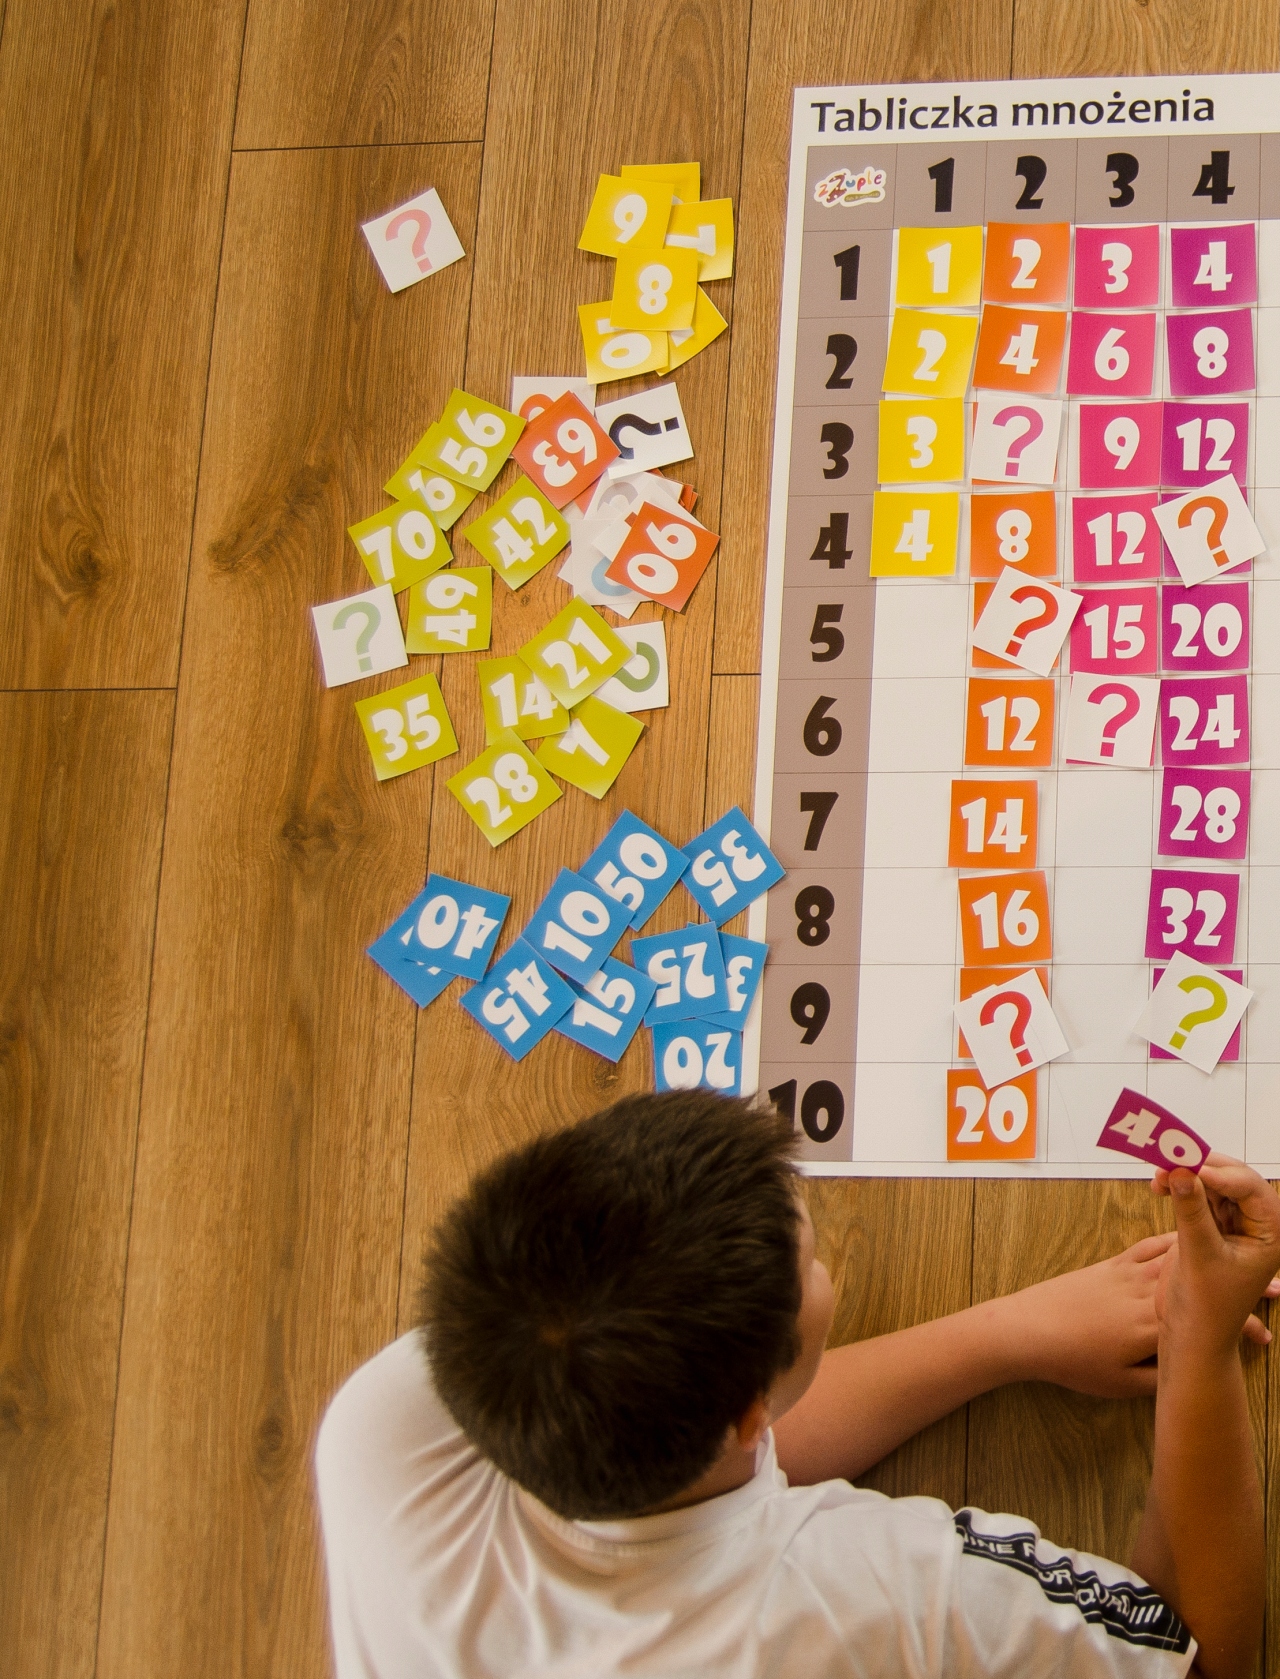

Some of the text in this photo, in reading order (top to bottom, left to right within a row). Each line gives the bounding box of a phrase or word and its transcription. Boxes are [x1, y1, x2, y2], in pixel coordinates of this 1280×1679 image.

[811, 89, 1215, 133] Tabliczka mnożenia
[927, 157, 955, 212] 1
[1015, 155, 1048, 209] 2
[1106, 152, 1139, 207] 3
[1192, 150, 1235, 204] 4
[614, 194, 647, 244] 9
[638, 264, 673, 315] 8
[833, 244, 860, 300] 1
[926, 242, 952, 293] 1
[1011, 238, 1042, 289] 2
[1101, 242, 1133, 294] 3
[1193, 241, 1233, 292] 4
[825, 333, 858, 389] 2
[913, 329, 947, 382] 2
[1000, 324, 1039, 375] 4
[1094, 327, 1130, 381] 6
[1192, 326, 1229, 379] 8
[439, 408, 506, 479] 56
[531, 418, 597, 488] 63
[820, 422, 854, 480] 3
[906, 416, 938, 469] 3
[1104, 416, 1140, 470] 9
[1175, 418, 1236, 471] 12
[360, 510, 437, 581] 70
[493, 497, 558, 570] 42
[627, 521, 697, 595] 90
[809, 513, 853, 569] 4
[894, 510, 934, 561] 4
[996, 509, 1032, 562] 8
[1086, 511, 1147, 567] 12
[425, 574, 479, 646] 49
[809, 604, 845, 662] 5
[1083, 604, 1146, 659] 15
[1171, 602, 1243, 657] 20
[542, 617, 613, 689] 21
[372, 693, 441, 761] 35
[490, 672, 558, 727] 14
[803, 696, 842, 756] 6
[980, 696, 1041, 751] 12
[1167, 695, 1241, 751] 24
[558, 718, 611, 767] 7
[466, 752, 539, 828] 28
[1169, 785, 1241, 843] 28
[800, 791, 839, 851] 7
[960, 797, 1028, 853] 14
[594, 832, 668, 910] 50
[692, 829, 767, 907] 35
[417, 894, 500, 960] 40
[543, 890, 610, 962] 10
[795, 885, 835, 947] 8
[971, 889, 1039, 949] 16
[1160, 887, 1227, 947] 32
[483, 960, 553, 1043] 45
[572, 970, 636, 1037] 15
[647, 942, 715, 1008] 25
[727, 955, 753, 1013] 3
[790, 982, 831, 1045] 9
[663, 1032, 735, 1091] 20
[768, 1079, 845, 1143] 10
[955, 1085, 1029, 1144] 20
[1108, 1107, 1203, 1168] 40
